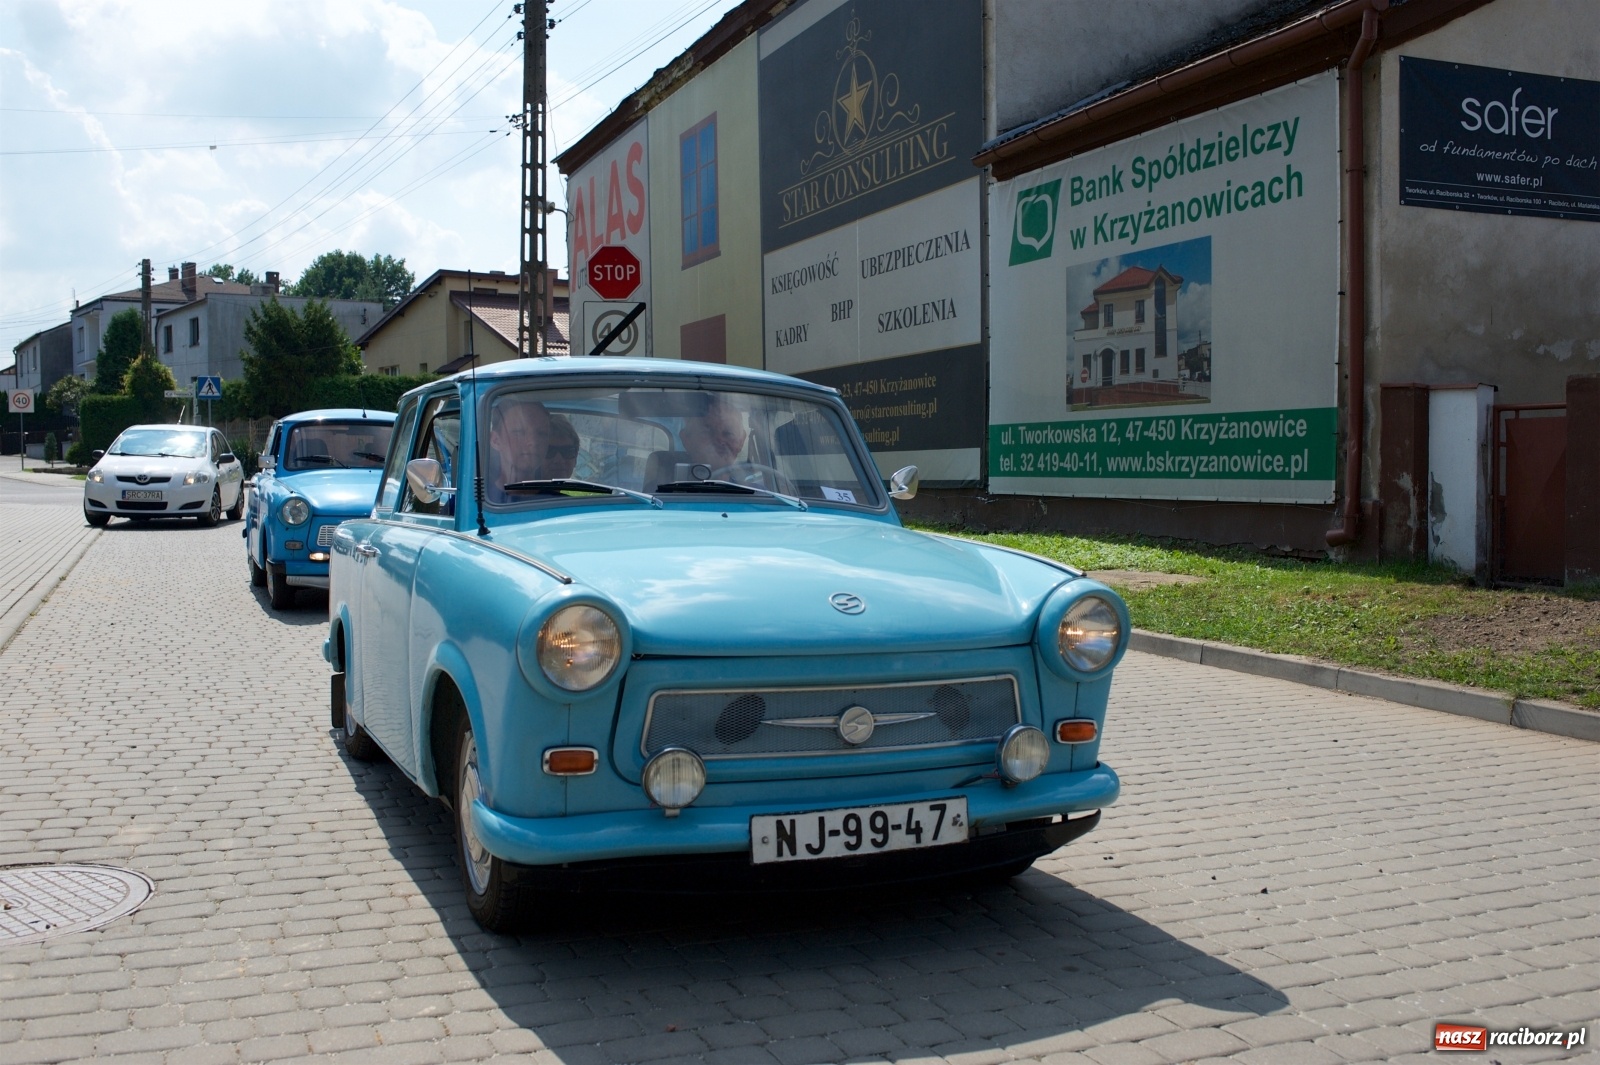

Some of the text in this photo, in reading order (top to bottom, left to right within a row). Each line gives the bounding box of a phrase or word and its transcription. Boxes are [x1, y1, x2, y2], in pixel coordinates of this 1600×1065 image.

[1460, 87, 1559, 140] safer
[1069, 116, 1300, 207] Bank Spółdzielczy
[1419, 140, 1598, 170] od fundamentów po dach
[782, 122, 948, 221] STAR CONSULTING
[1476, 171, 1543, 189] www.safer.pl
[571, 141, 646, 293] ALAS
[1069, 164, 1303, 250] w Krzyżanowicach
[593, 265, 636, 281] STOP
[771, 228, 971, 295] KSIĘGOWOŚĆ UBEZPIECZENIA
[831, 299, 854, 322] BHP
[877, 297, 957, 334] SZKOLENIA
[775, 323, 810, 348] KADRY
[15, 396, 28, 405] 40
[842, 372, 937, 399] 23, 47-450 Krzyżanowice
[849, 397, 937, 423] iuro@starconsulting.pl
[1001, 413, 1308, 447] ul. Tworkowska 12, 47-450 Krzyżanowice
[999, 448, 1309, 478] tel. 32 419-40-11, www.bskrzyzanowice.pl
[835, 491, 852, 502] 35
